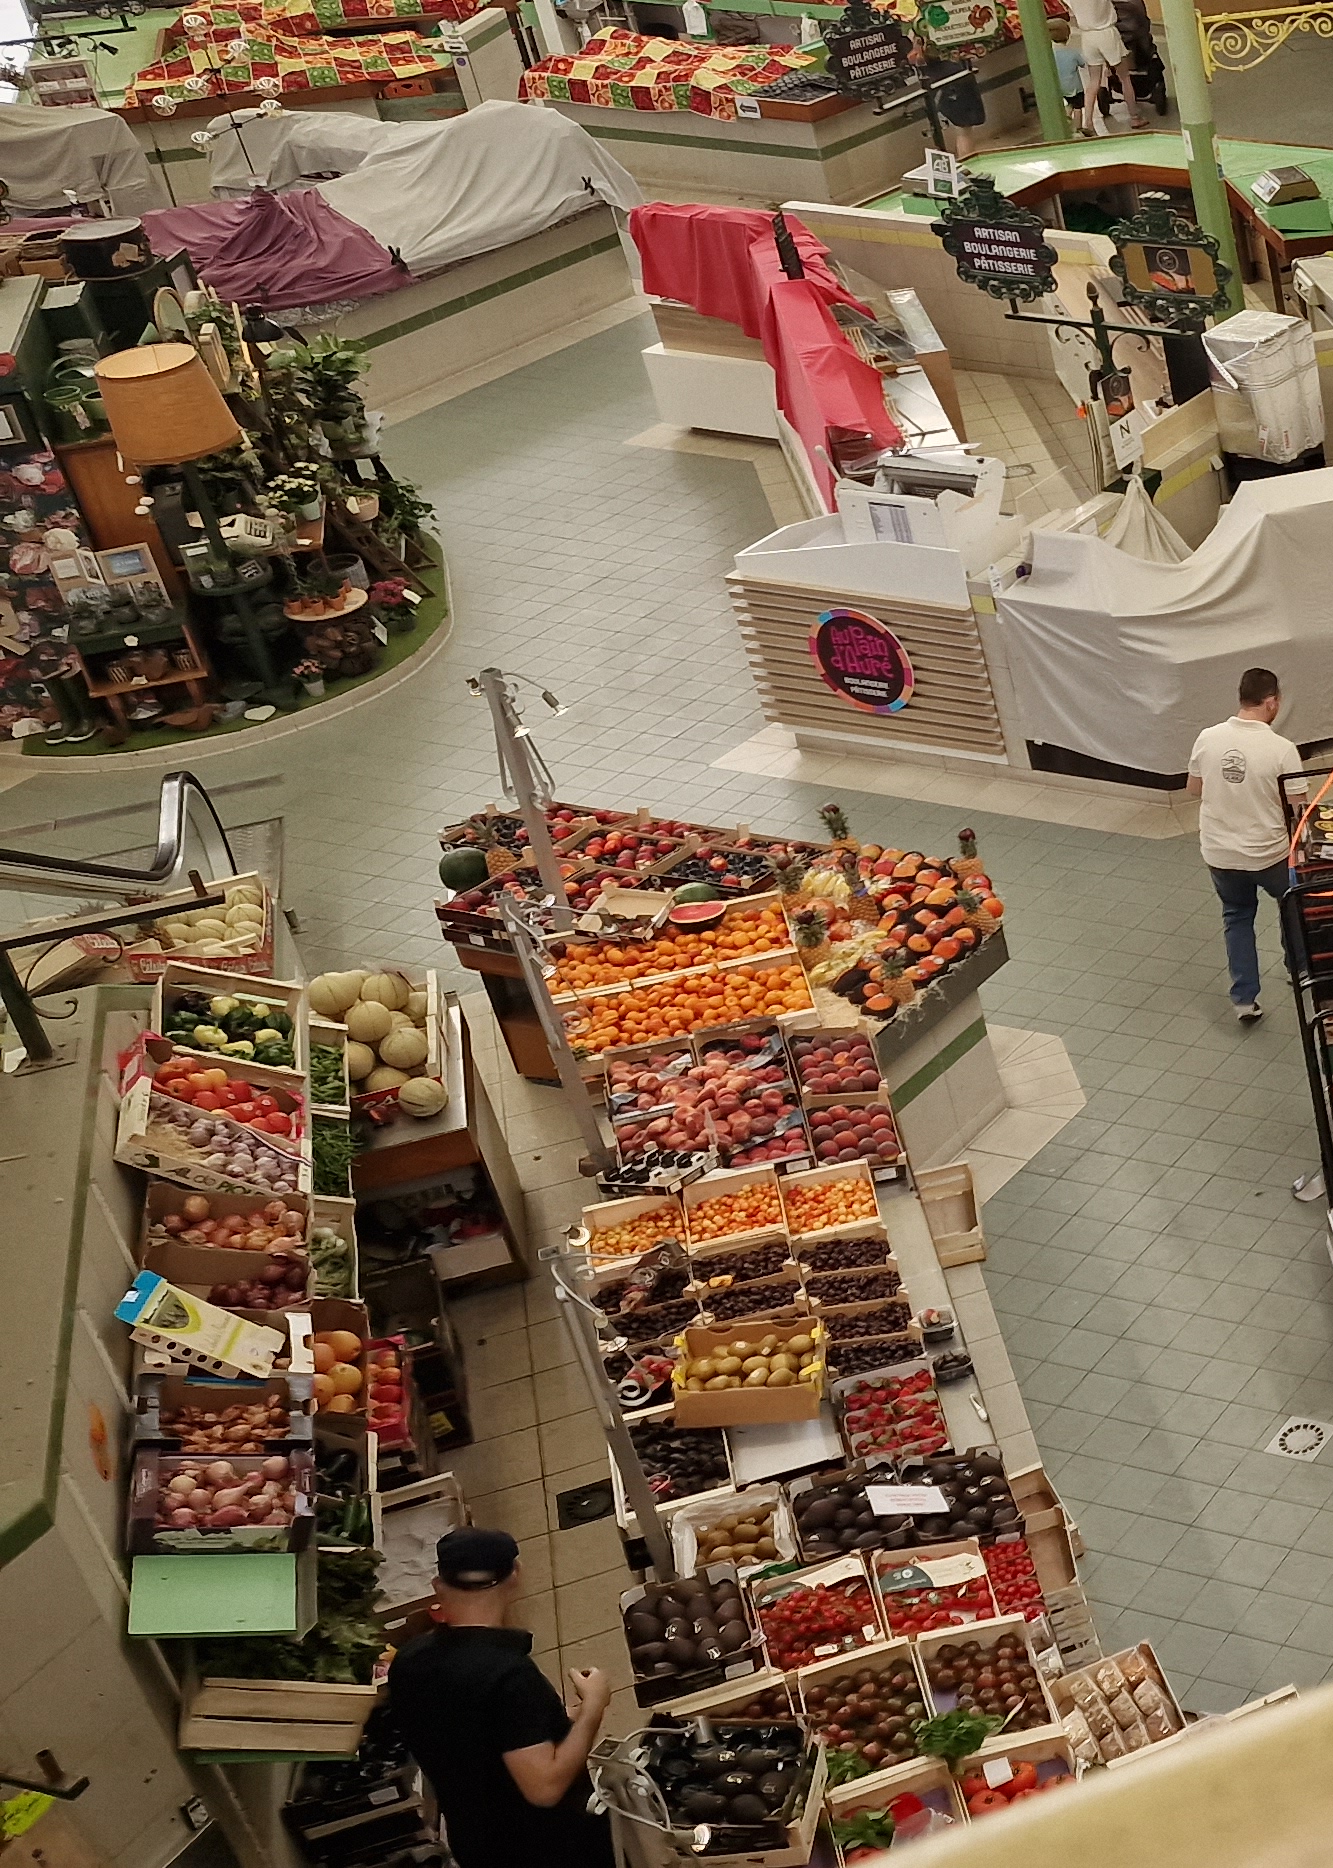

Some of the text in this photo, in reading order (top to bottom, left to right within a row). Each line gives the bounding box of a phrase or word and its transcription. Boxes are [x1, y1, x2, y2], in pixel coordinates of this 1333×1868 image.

[850, 32, 885, 50] ARTISAN
[841, 43, 898, 67] BOULANGERIE
[849, 58, 896, 79] PÂTISSERIE
[974, 227, 1020, 242] ARTISAN
[963, 241, 1038, 260] BOULANGERIE
[973, 256, 1035, 275] PÂTISSERIE
